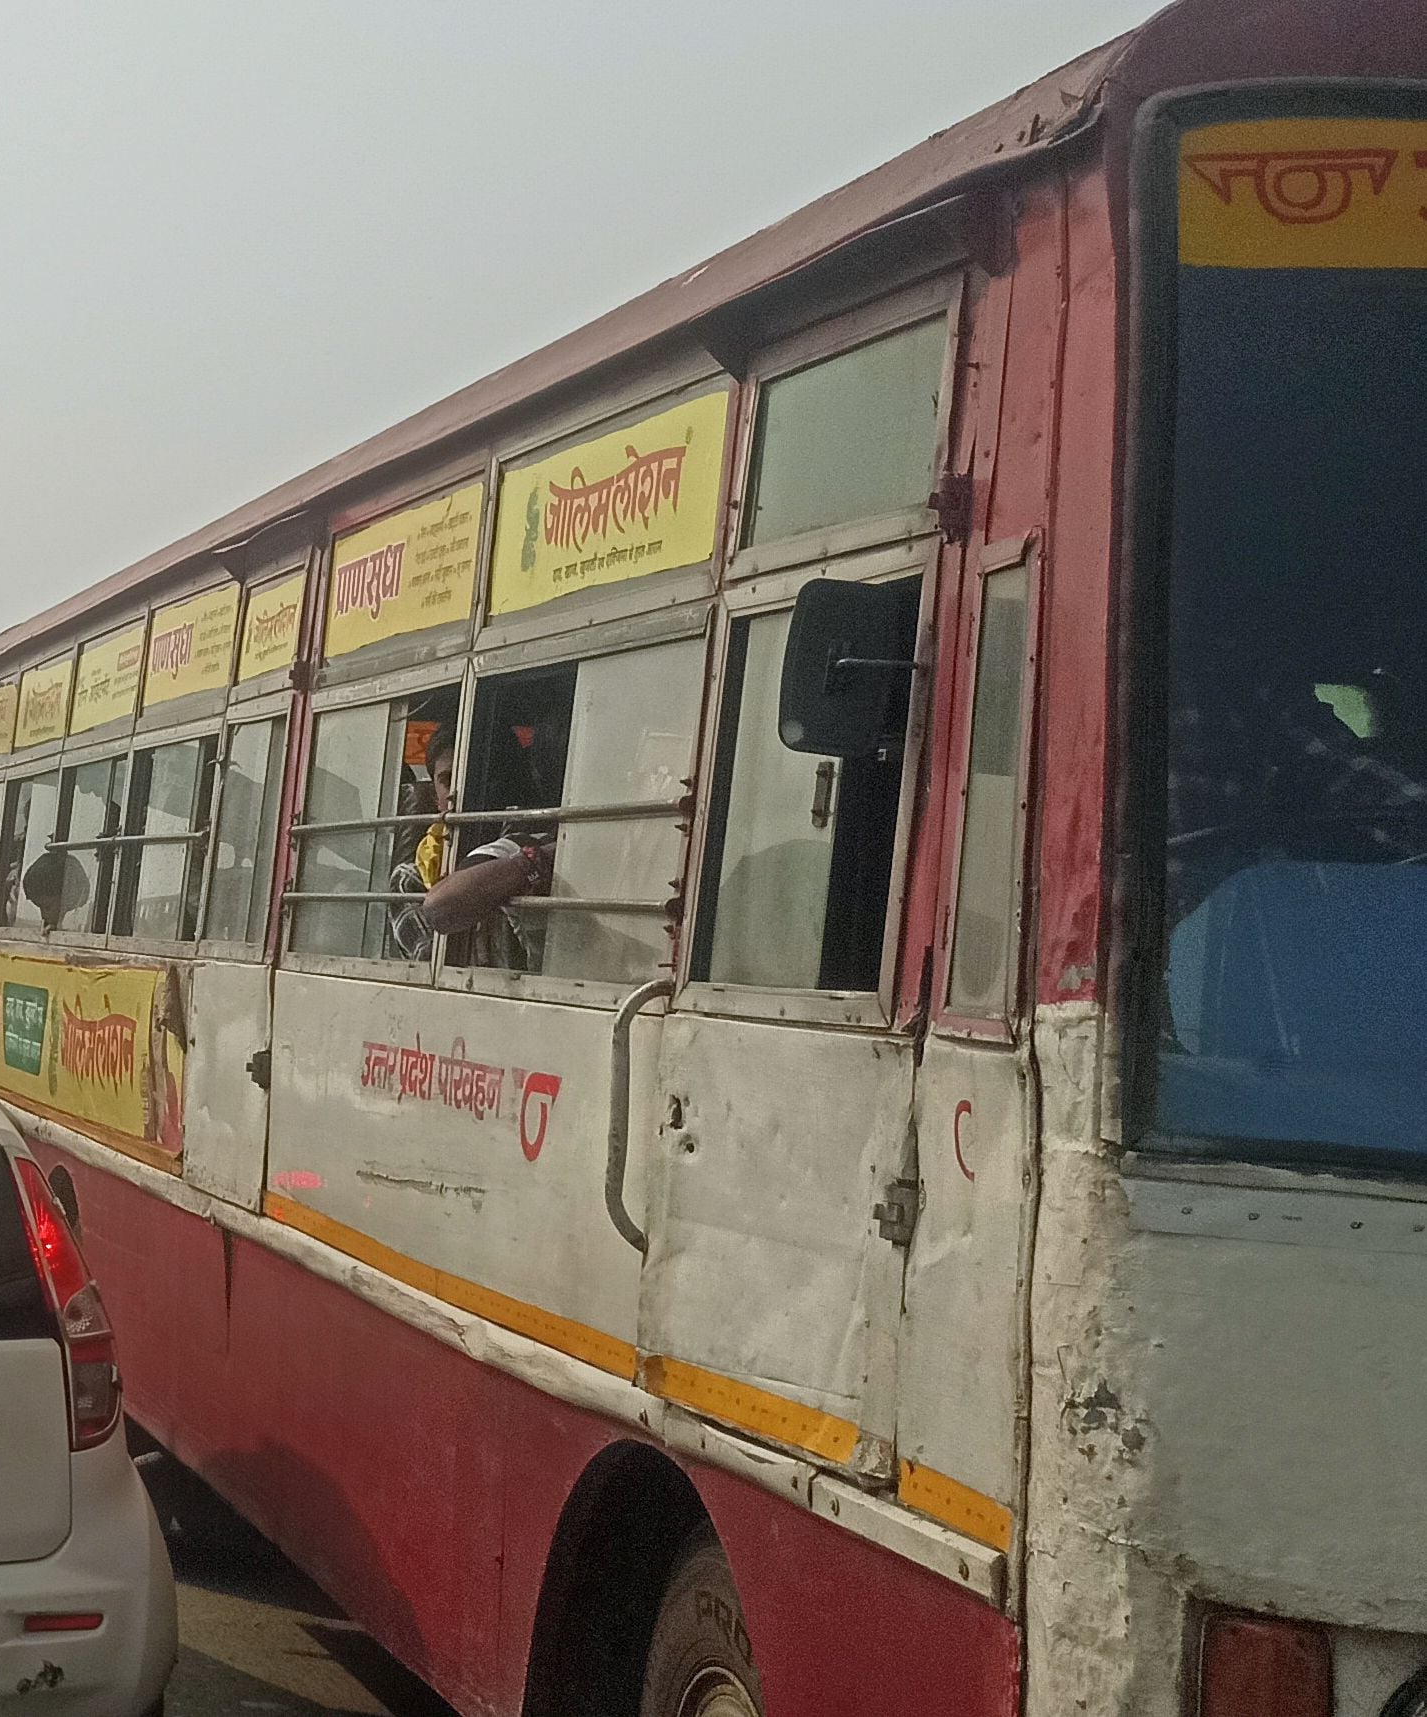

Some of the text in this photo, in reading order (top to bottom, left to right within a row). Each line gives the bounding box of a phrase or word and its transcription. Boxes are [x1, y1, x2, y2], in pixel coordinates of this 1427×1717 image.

[361, 1030, 505, 1121] उत्तर प्रदेश परिवहन
